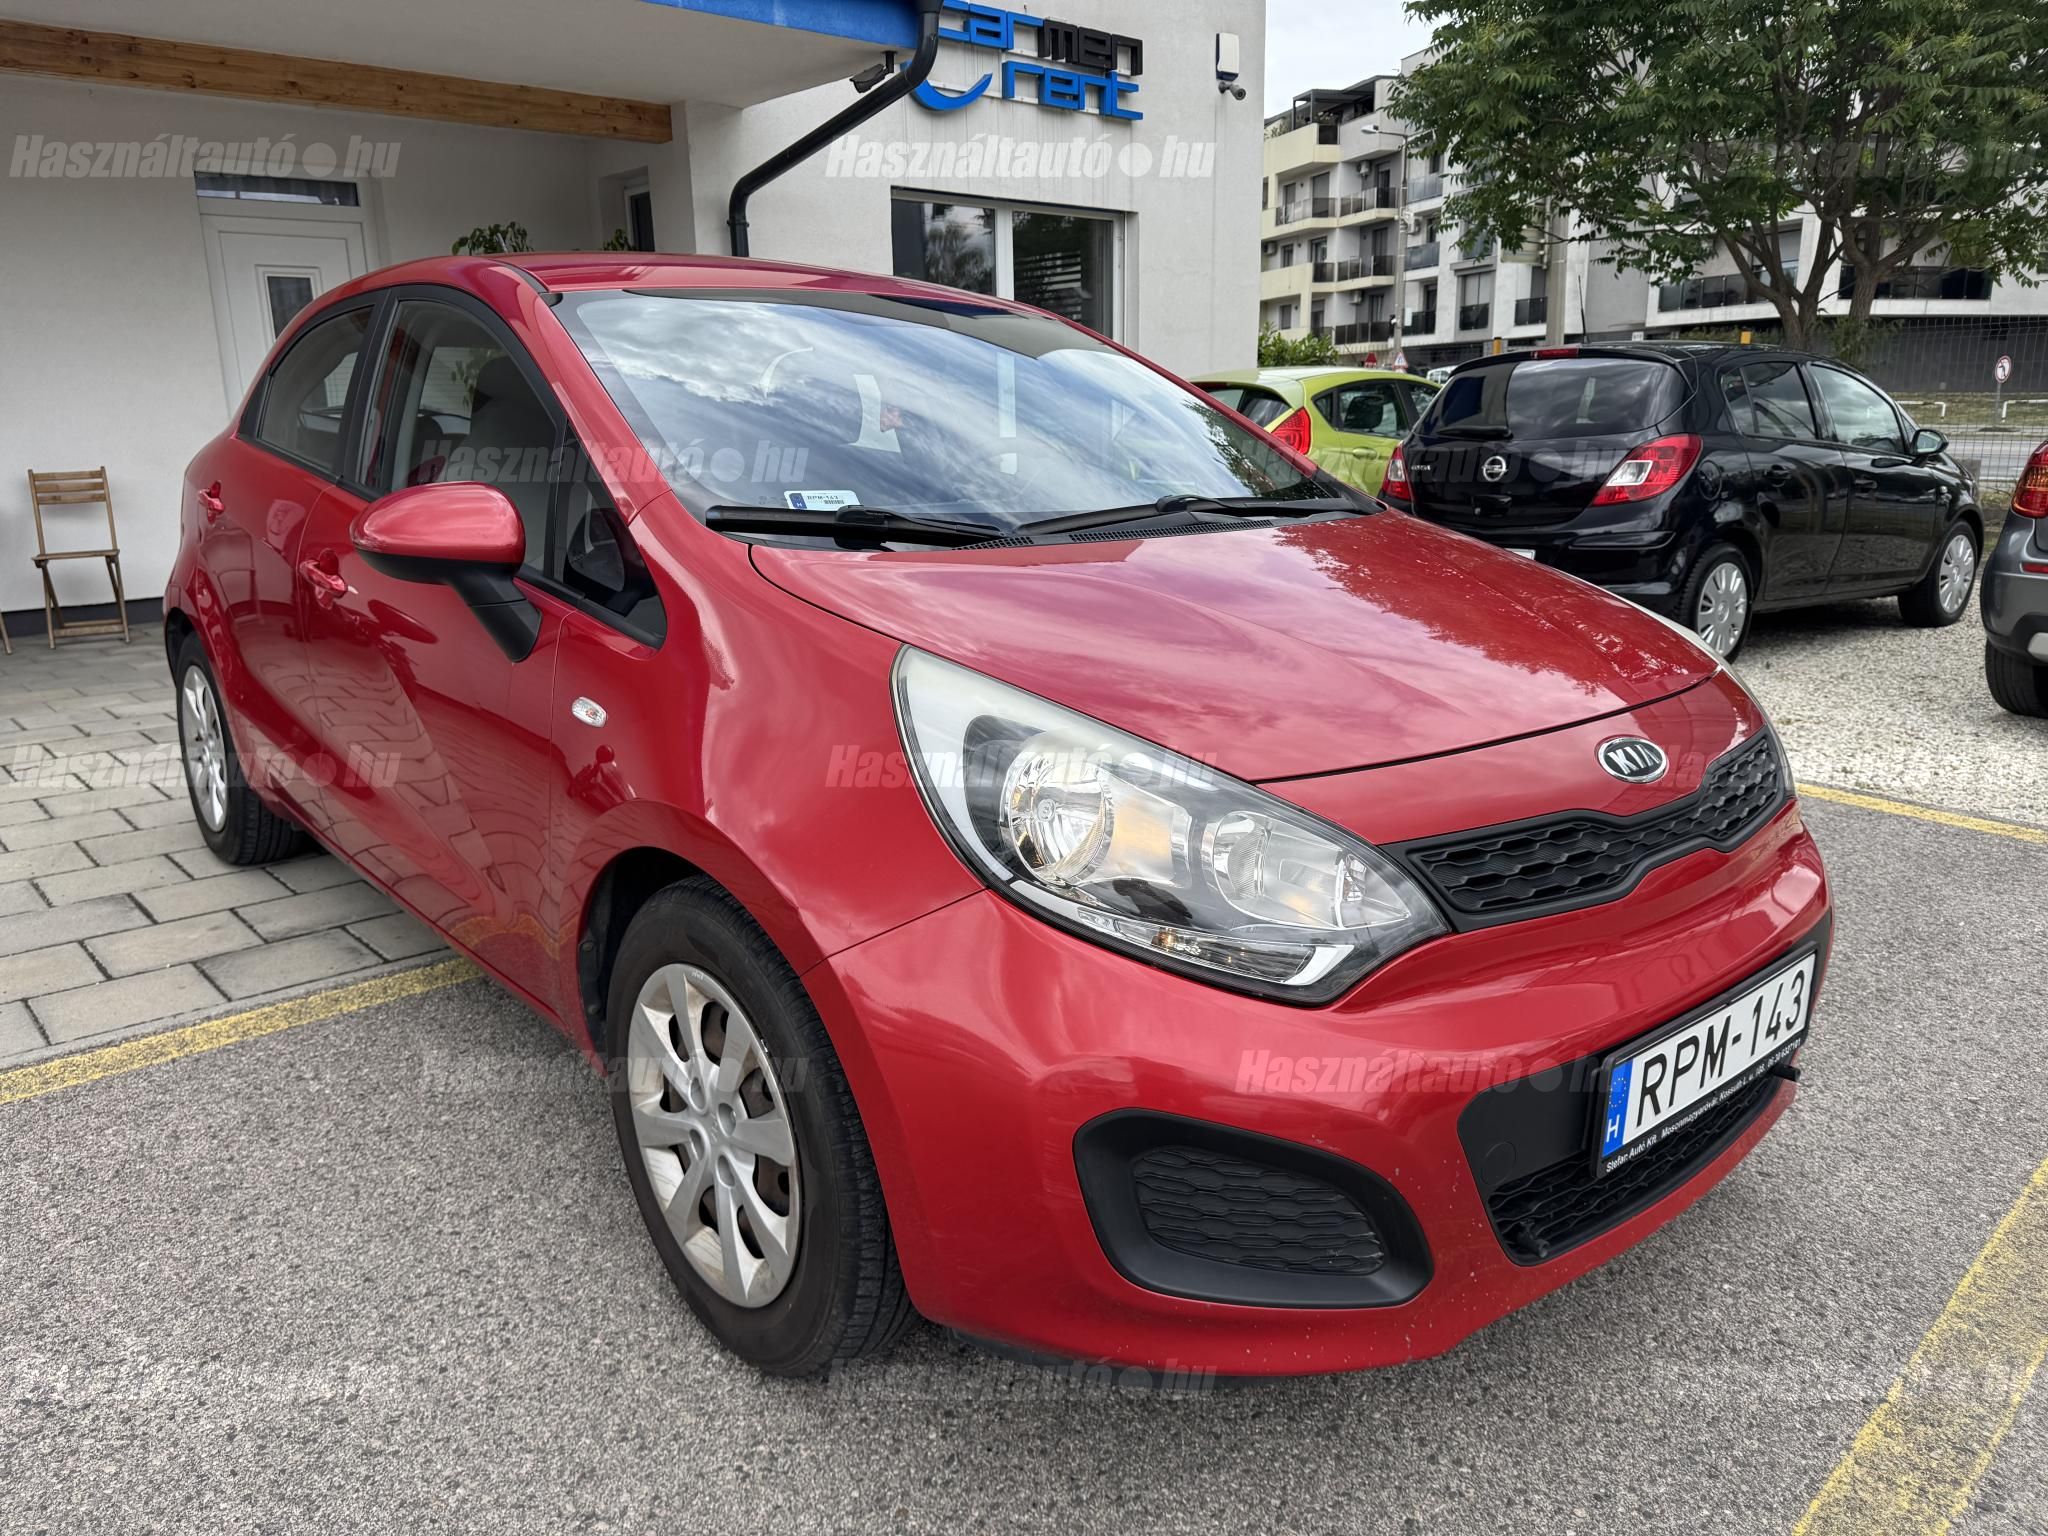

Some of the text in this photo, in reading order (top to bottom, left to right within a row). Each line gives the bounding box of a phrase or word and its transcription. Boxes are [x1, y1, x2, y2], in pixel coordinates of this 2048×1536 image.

[1001, 61, 1143, 120] rent
[1608, 743, 1661, 775] KIA
[1636, 969, 1805, 1128] RPM-143
[1606, 1114, 1620, 1142] H
